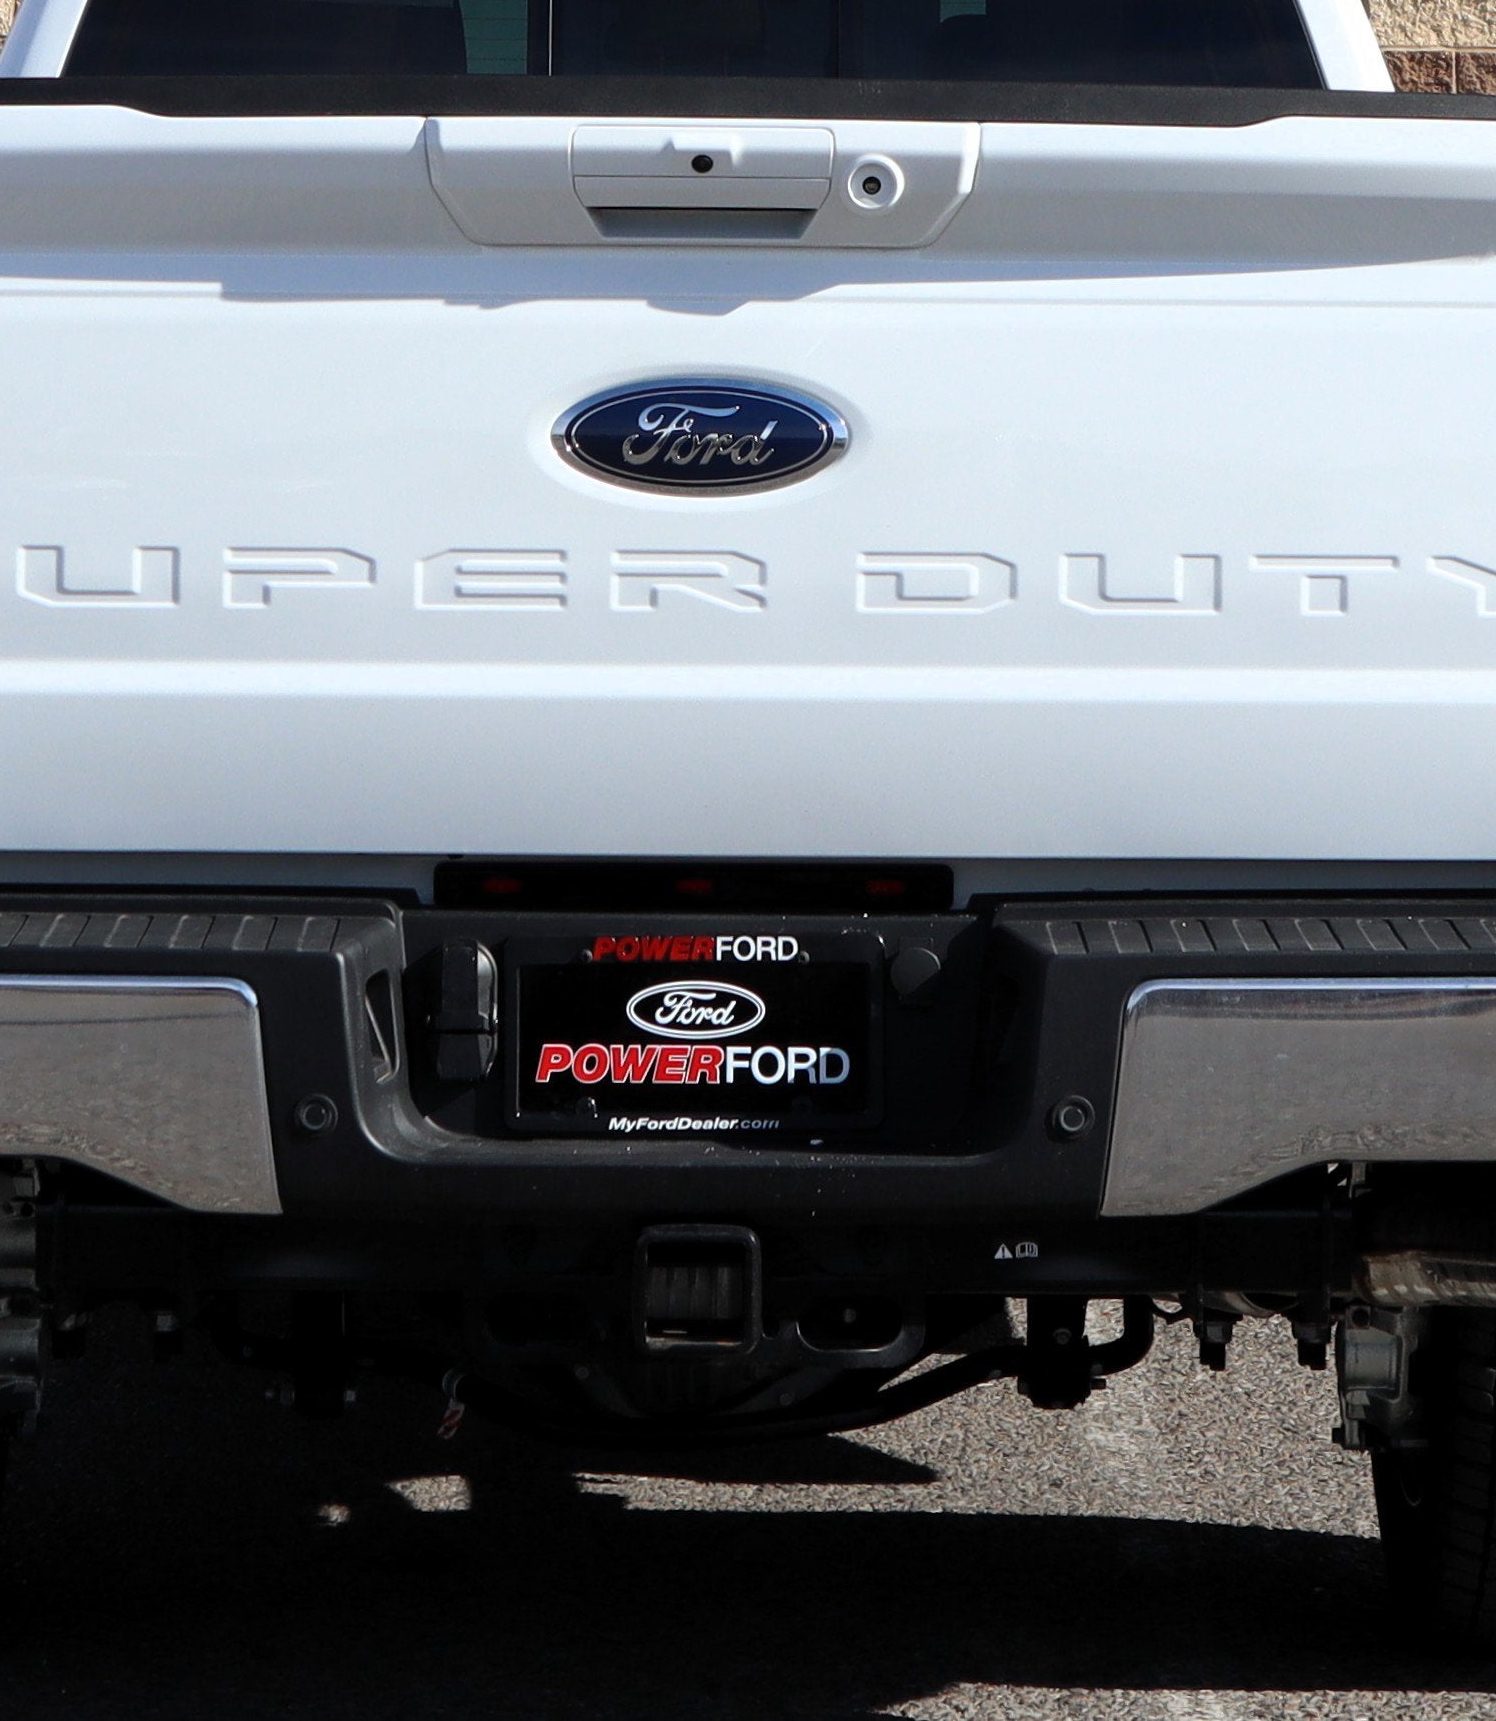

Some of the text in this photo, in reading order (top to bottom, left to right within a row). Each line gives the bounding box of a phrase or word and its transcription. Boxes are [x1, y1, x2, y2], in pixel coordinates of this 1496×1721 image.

[622, 402, 778, 465] Ford
[593, 935, 799, 962] POWERFORD
[655, 990, 735, 1026] Ford
[535, 1043, 851, 1085] POWERFORD
[608, 1116, 780, 1133] MyFordDealer.com
